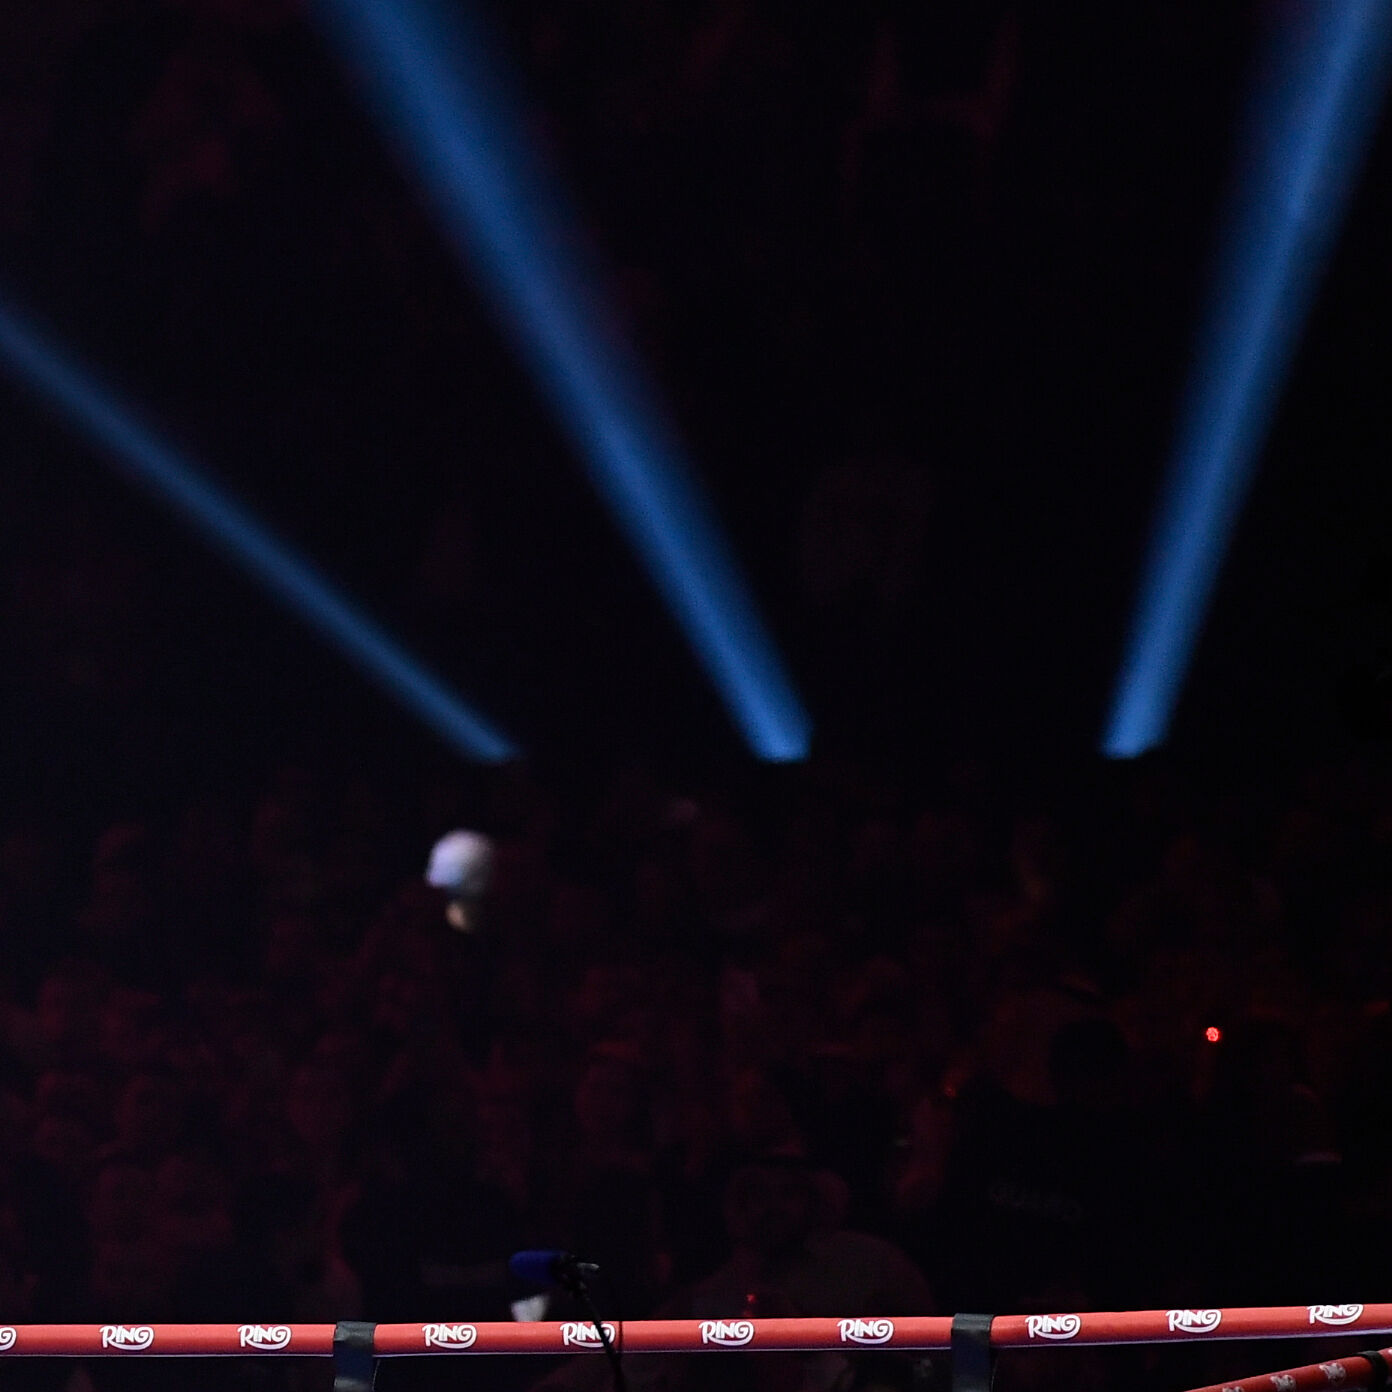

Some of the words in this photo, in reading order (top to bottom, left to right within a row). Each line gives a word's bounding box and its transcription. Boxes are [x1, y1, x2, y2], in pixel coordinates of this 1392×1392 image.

[1024, 1314, 1080, 1339] RING
[1165, 1309, 1221, 1334] RING
[1306, 1304, 1363, 1325] RING
[99, 1325, 154, 1351] RING
[237, 1324, 291, 1350] RING
[422, 1323, 477, 1349] RING
[559, 1322, 615, 1348] RING
[698, 1320, 754, 1346] RING
[837, 1319, 894, 1344] RING
